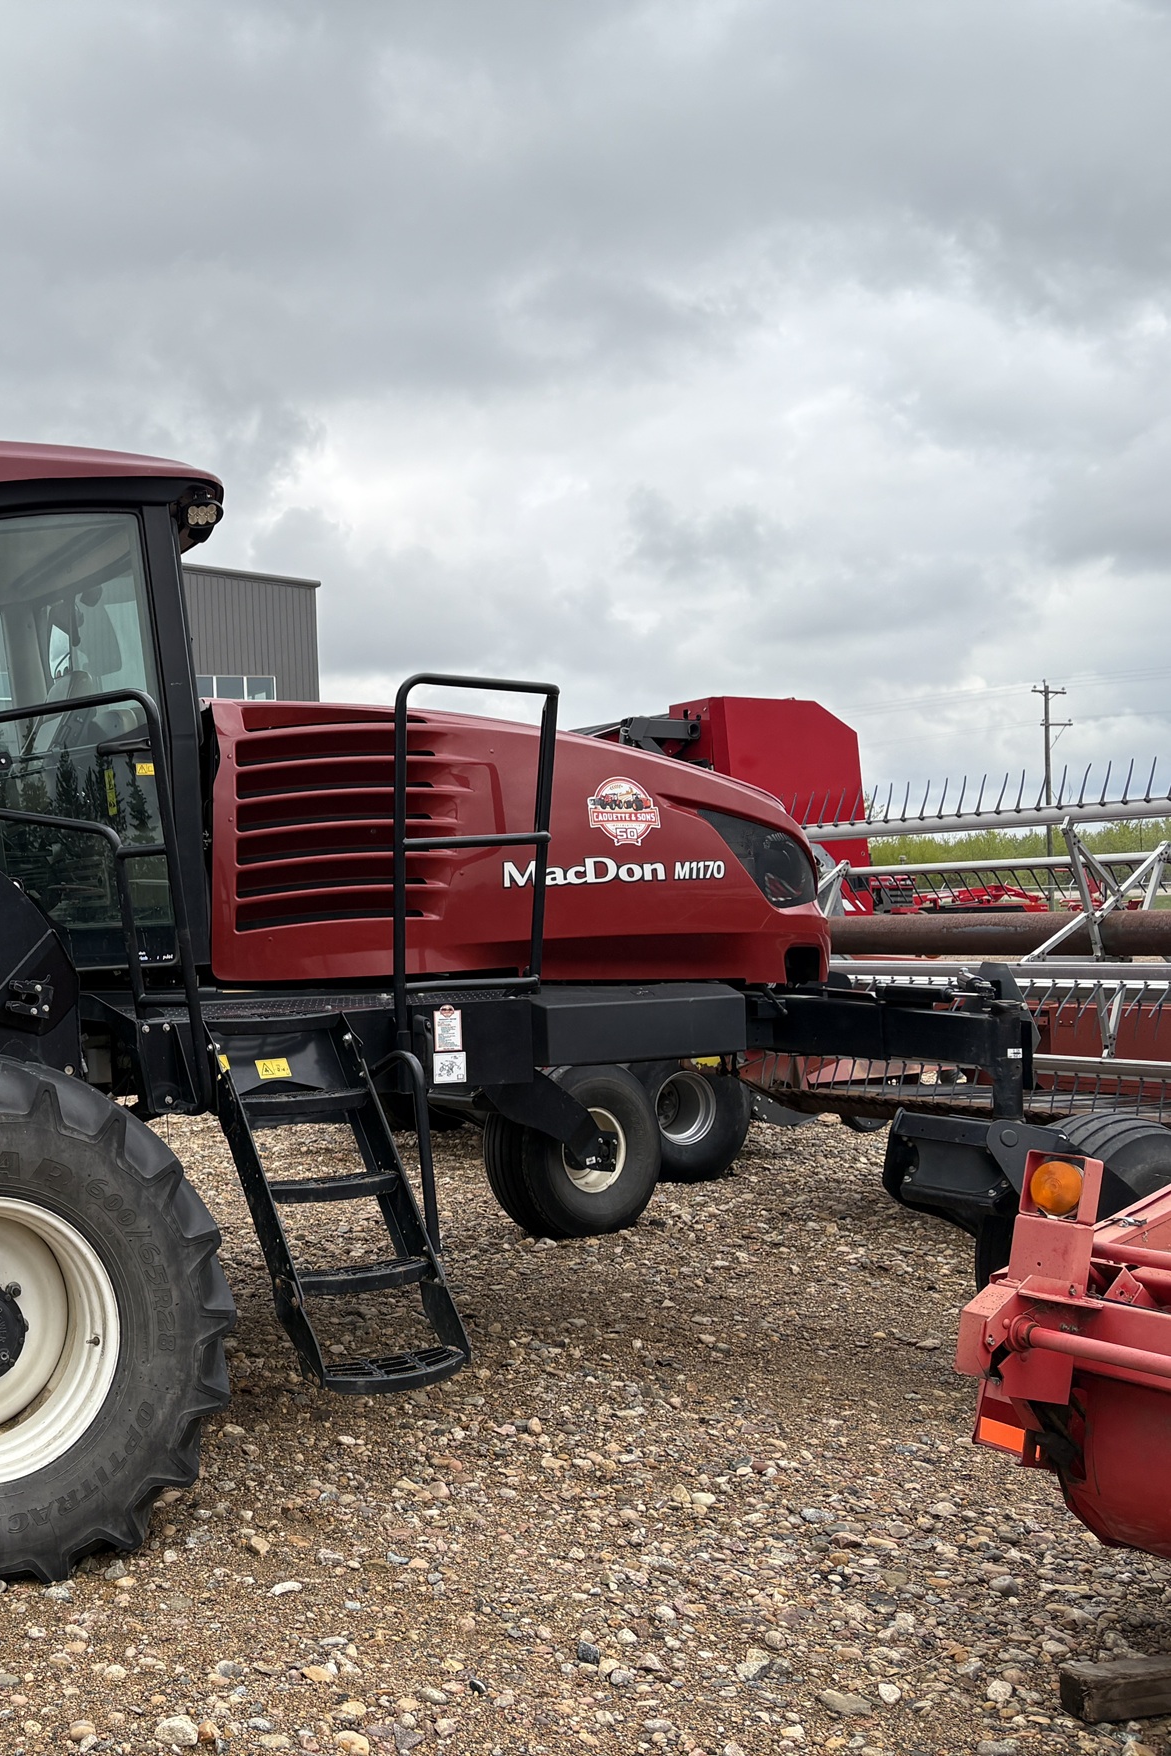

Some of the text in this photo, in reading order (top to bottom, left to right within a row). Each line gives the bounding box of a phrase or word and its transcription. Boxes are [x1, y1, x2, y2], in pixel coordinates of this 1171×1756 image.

[631, 812, 637, 821] &
[637, 812, 656, 822] SONS
[616, 828, 638, 840] 50
[503, 857, 725, 888] MacDon M1170
[85, 1178, 177, 1352] 600/65R28
[7, 1400, 155, 1535] OPTITRAC
